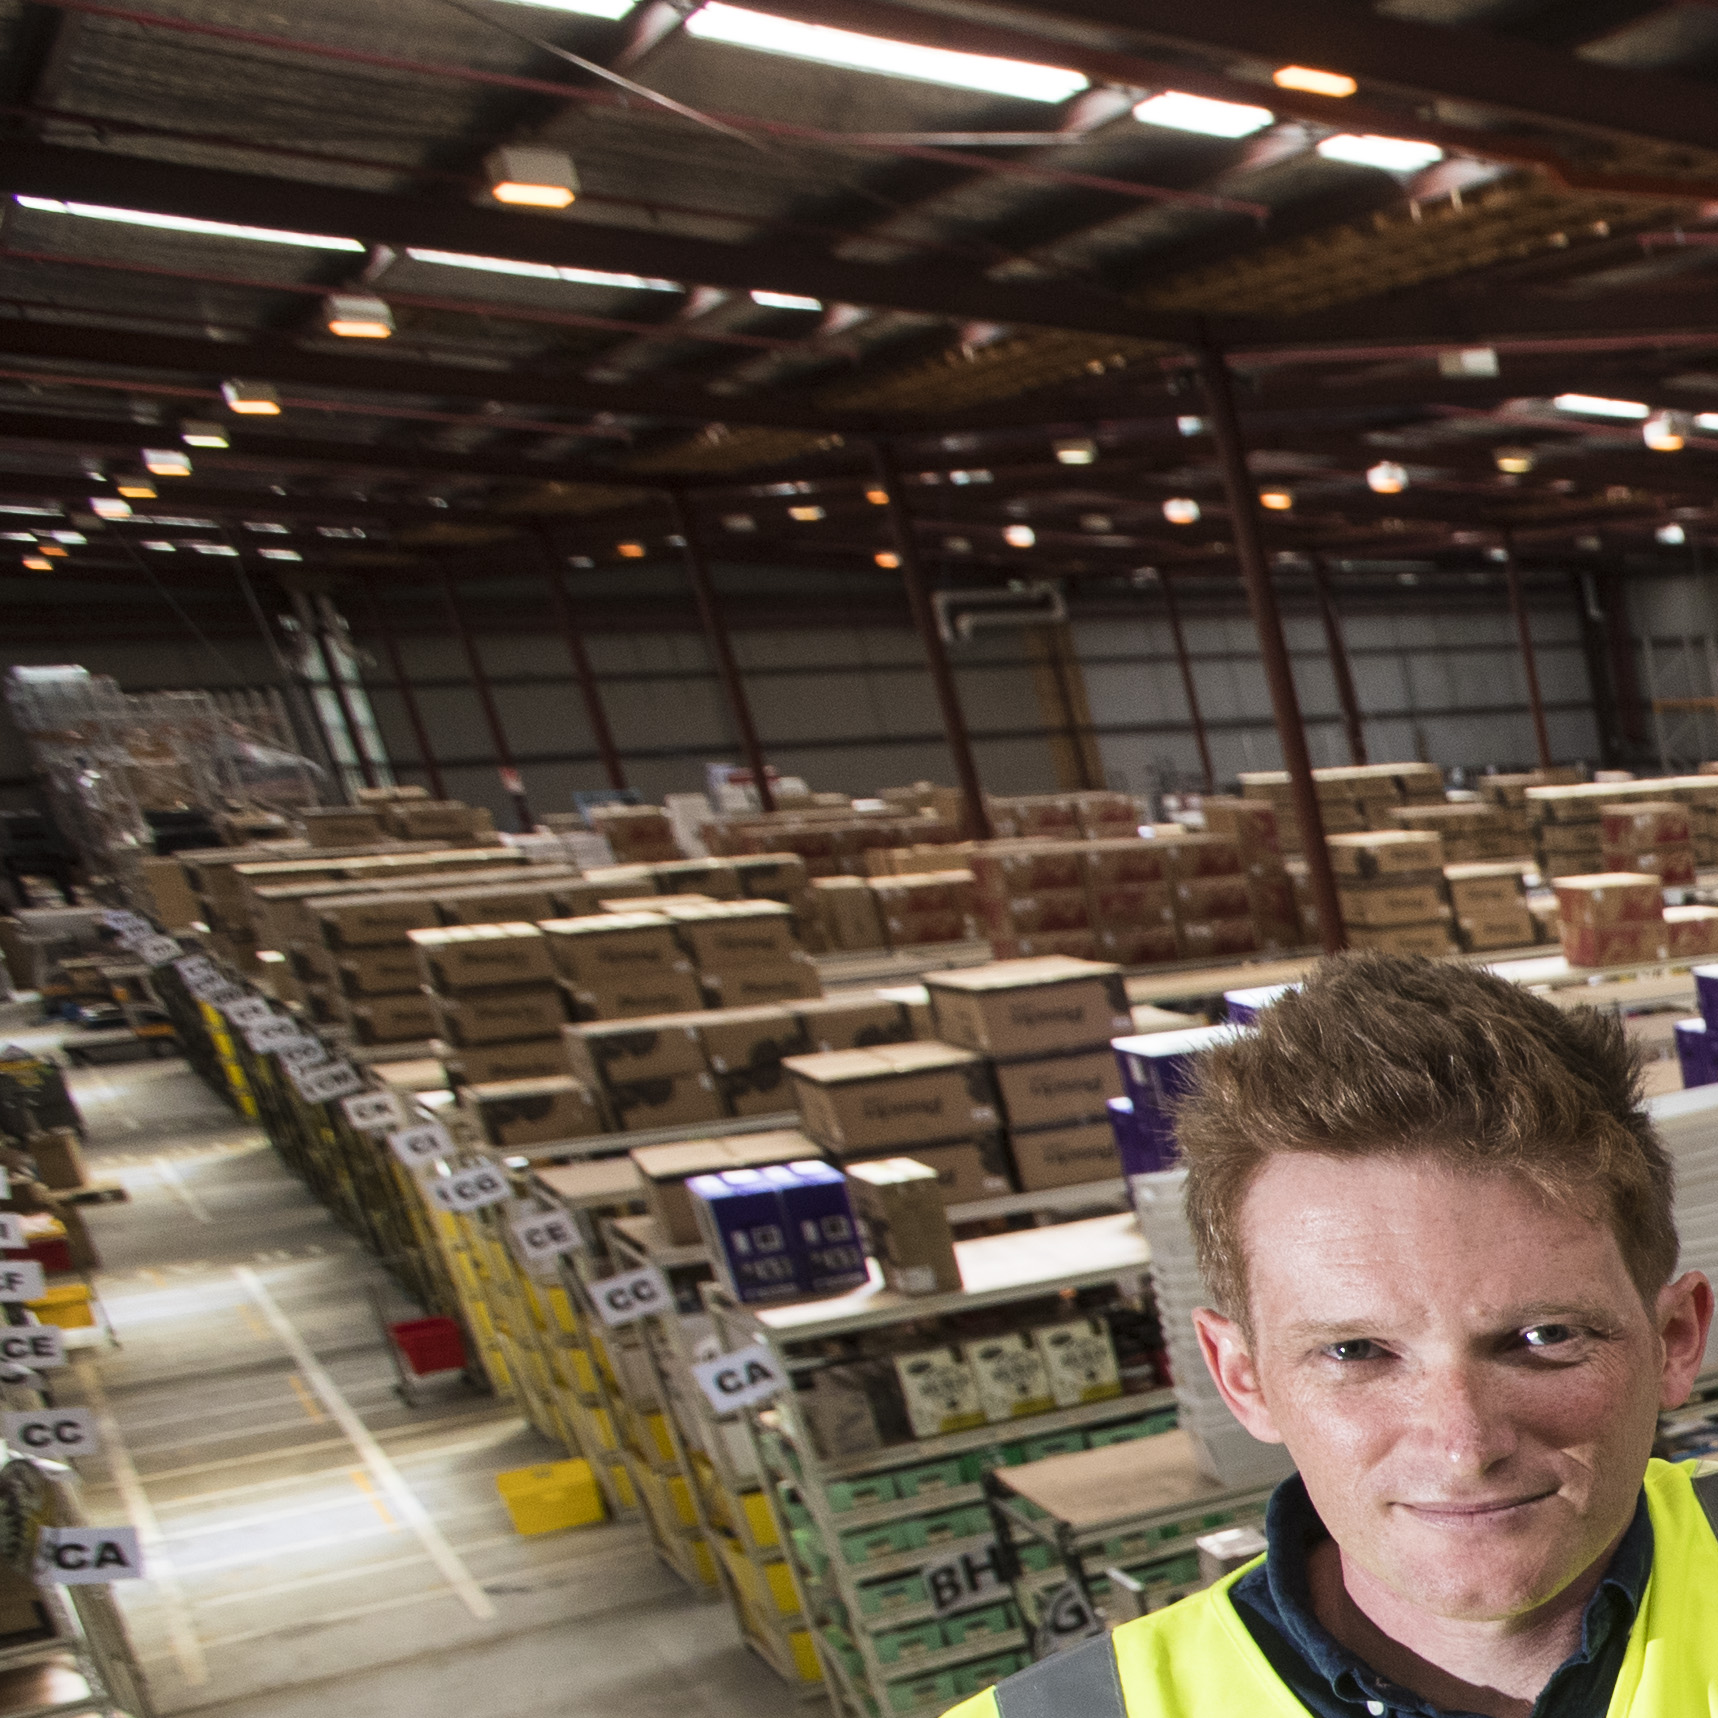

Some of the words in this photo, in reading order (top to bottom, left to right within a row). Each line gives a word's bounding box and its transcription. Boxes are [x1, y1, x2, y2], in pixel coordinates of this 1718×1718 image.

[525, 1221, 568, 1248] CE
[606, 1278, 657, 1311] CC
[1, 1335, 55, 1359] CE
[713, 1360, 774, 1394] CA
[20, 1420, 85, 1448] CC
[52, 1540, 130, 1571] CA
[929, 1548, 1000, 1610] BH
